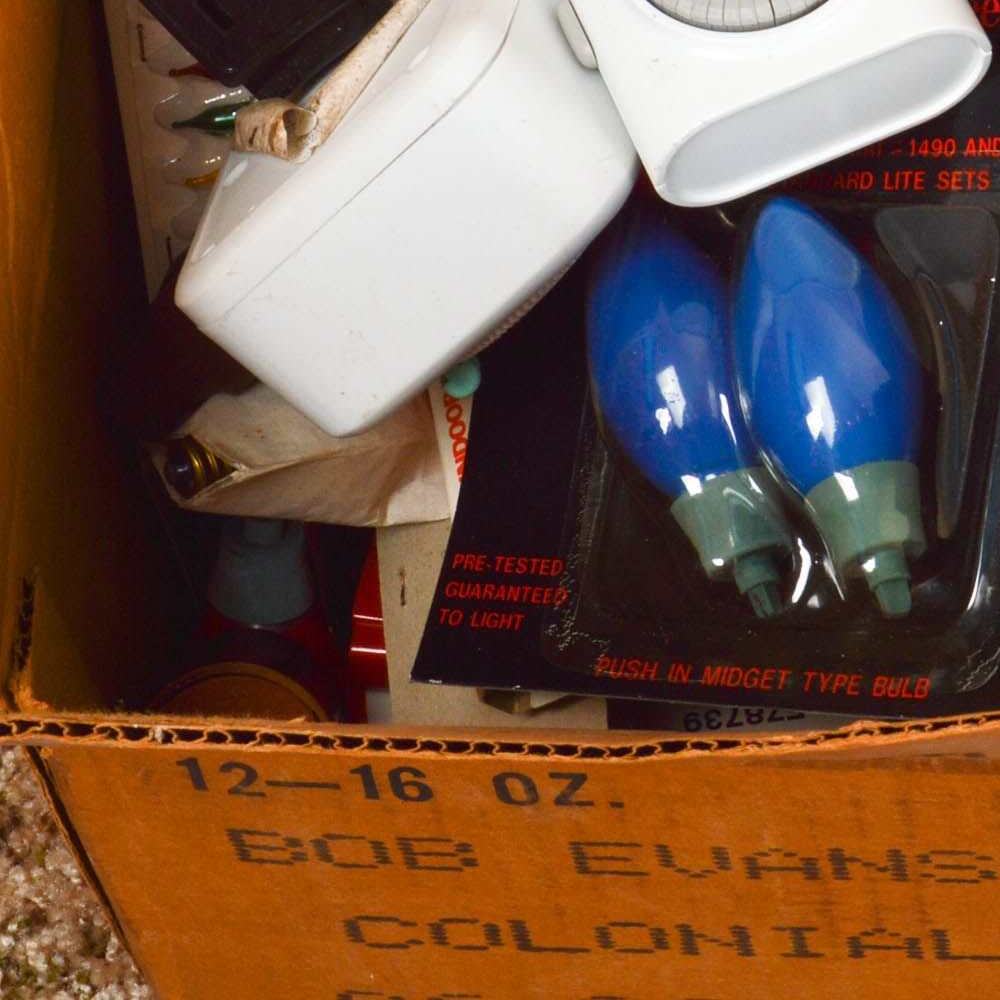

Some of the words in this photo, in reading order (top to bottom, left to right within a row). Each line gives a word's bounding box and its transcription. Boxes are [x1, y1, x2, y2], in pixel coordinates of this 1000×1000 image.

[909, 138, 957, 157] 1490
[884, 171, 925, 190] LITE
[937, 171, 991, 190] SETS
[452, 554, 563, 577] PRE-TESTED
[445, 581, 568, 605] GUARANTEED
[440, 609, 463, 626] TO
[471, 611, 525, 630] LIGHT
[594, 655, 660, 680] PUSH
[668, 663, 694, 684] IN
[701, 665, 792, 690] MIDGET
[804, 671, 864, 695] TYPE
[873, 675, 931, 699] BULB
[493, 770, 625, 810] OZ.
[226, 827, 479, 873] BOB
[570, 841, 998, 884] EVANS
